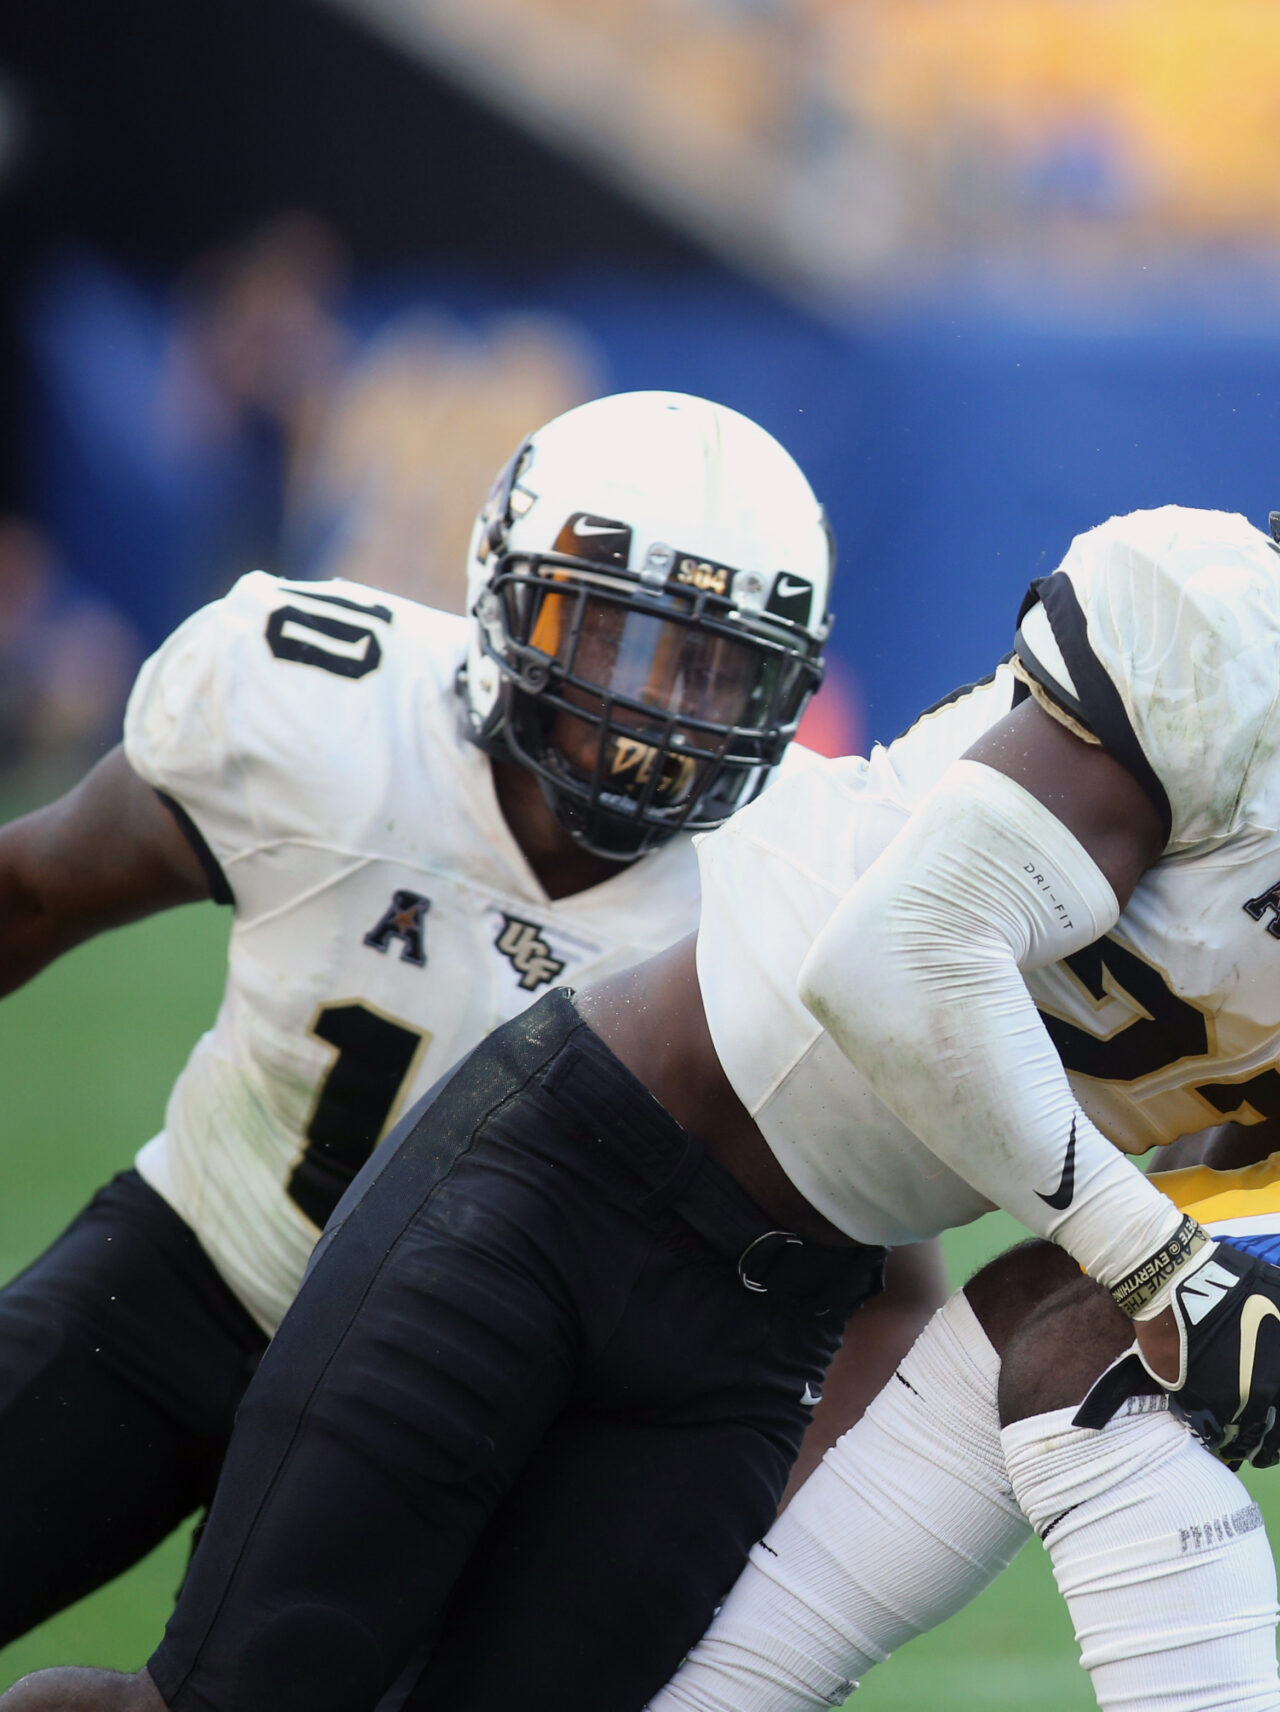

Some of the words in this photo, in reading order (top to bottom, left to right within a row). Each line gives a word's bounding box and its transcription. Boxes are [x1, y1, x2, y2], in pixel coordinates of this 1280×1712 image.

[1023, 862, 1074, 929] DRI-FIT
[494, 911, 565, 992] UCF
[1146, 1243, 1192, 1296] ABOVE
[1168, 1240, 1181, 1255] @
[1122, 1293, 1149, 1316] THE
